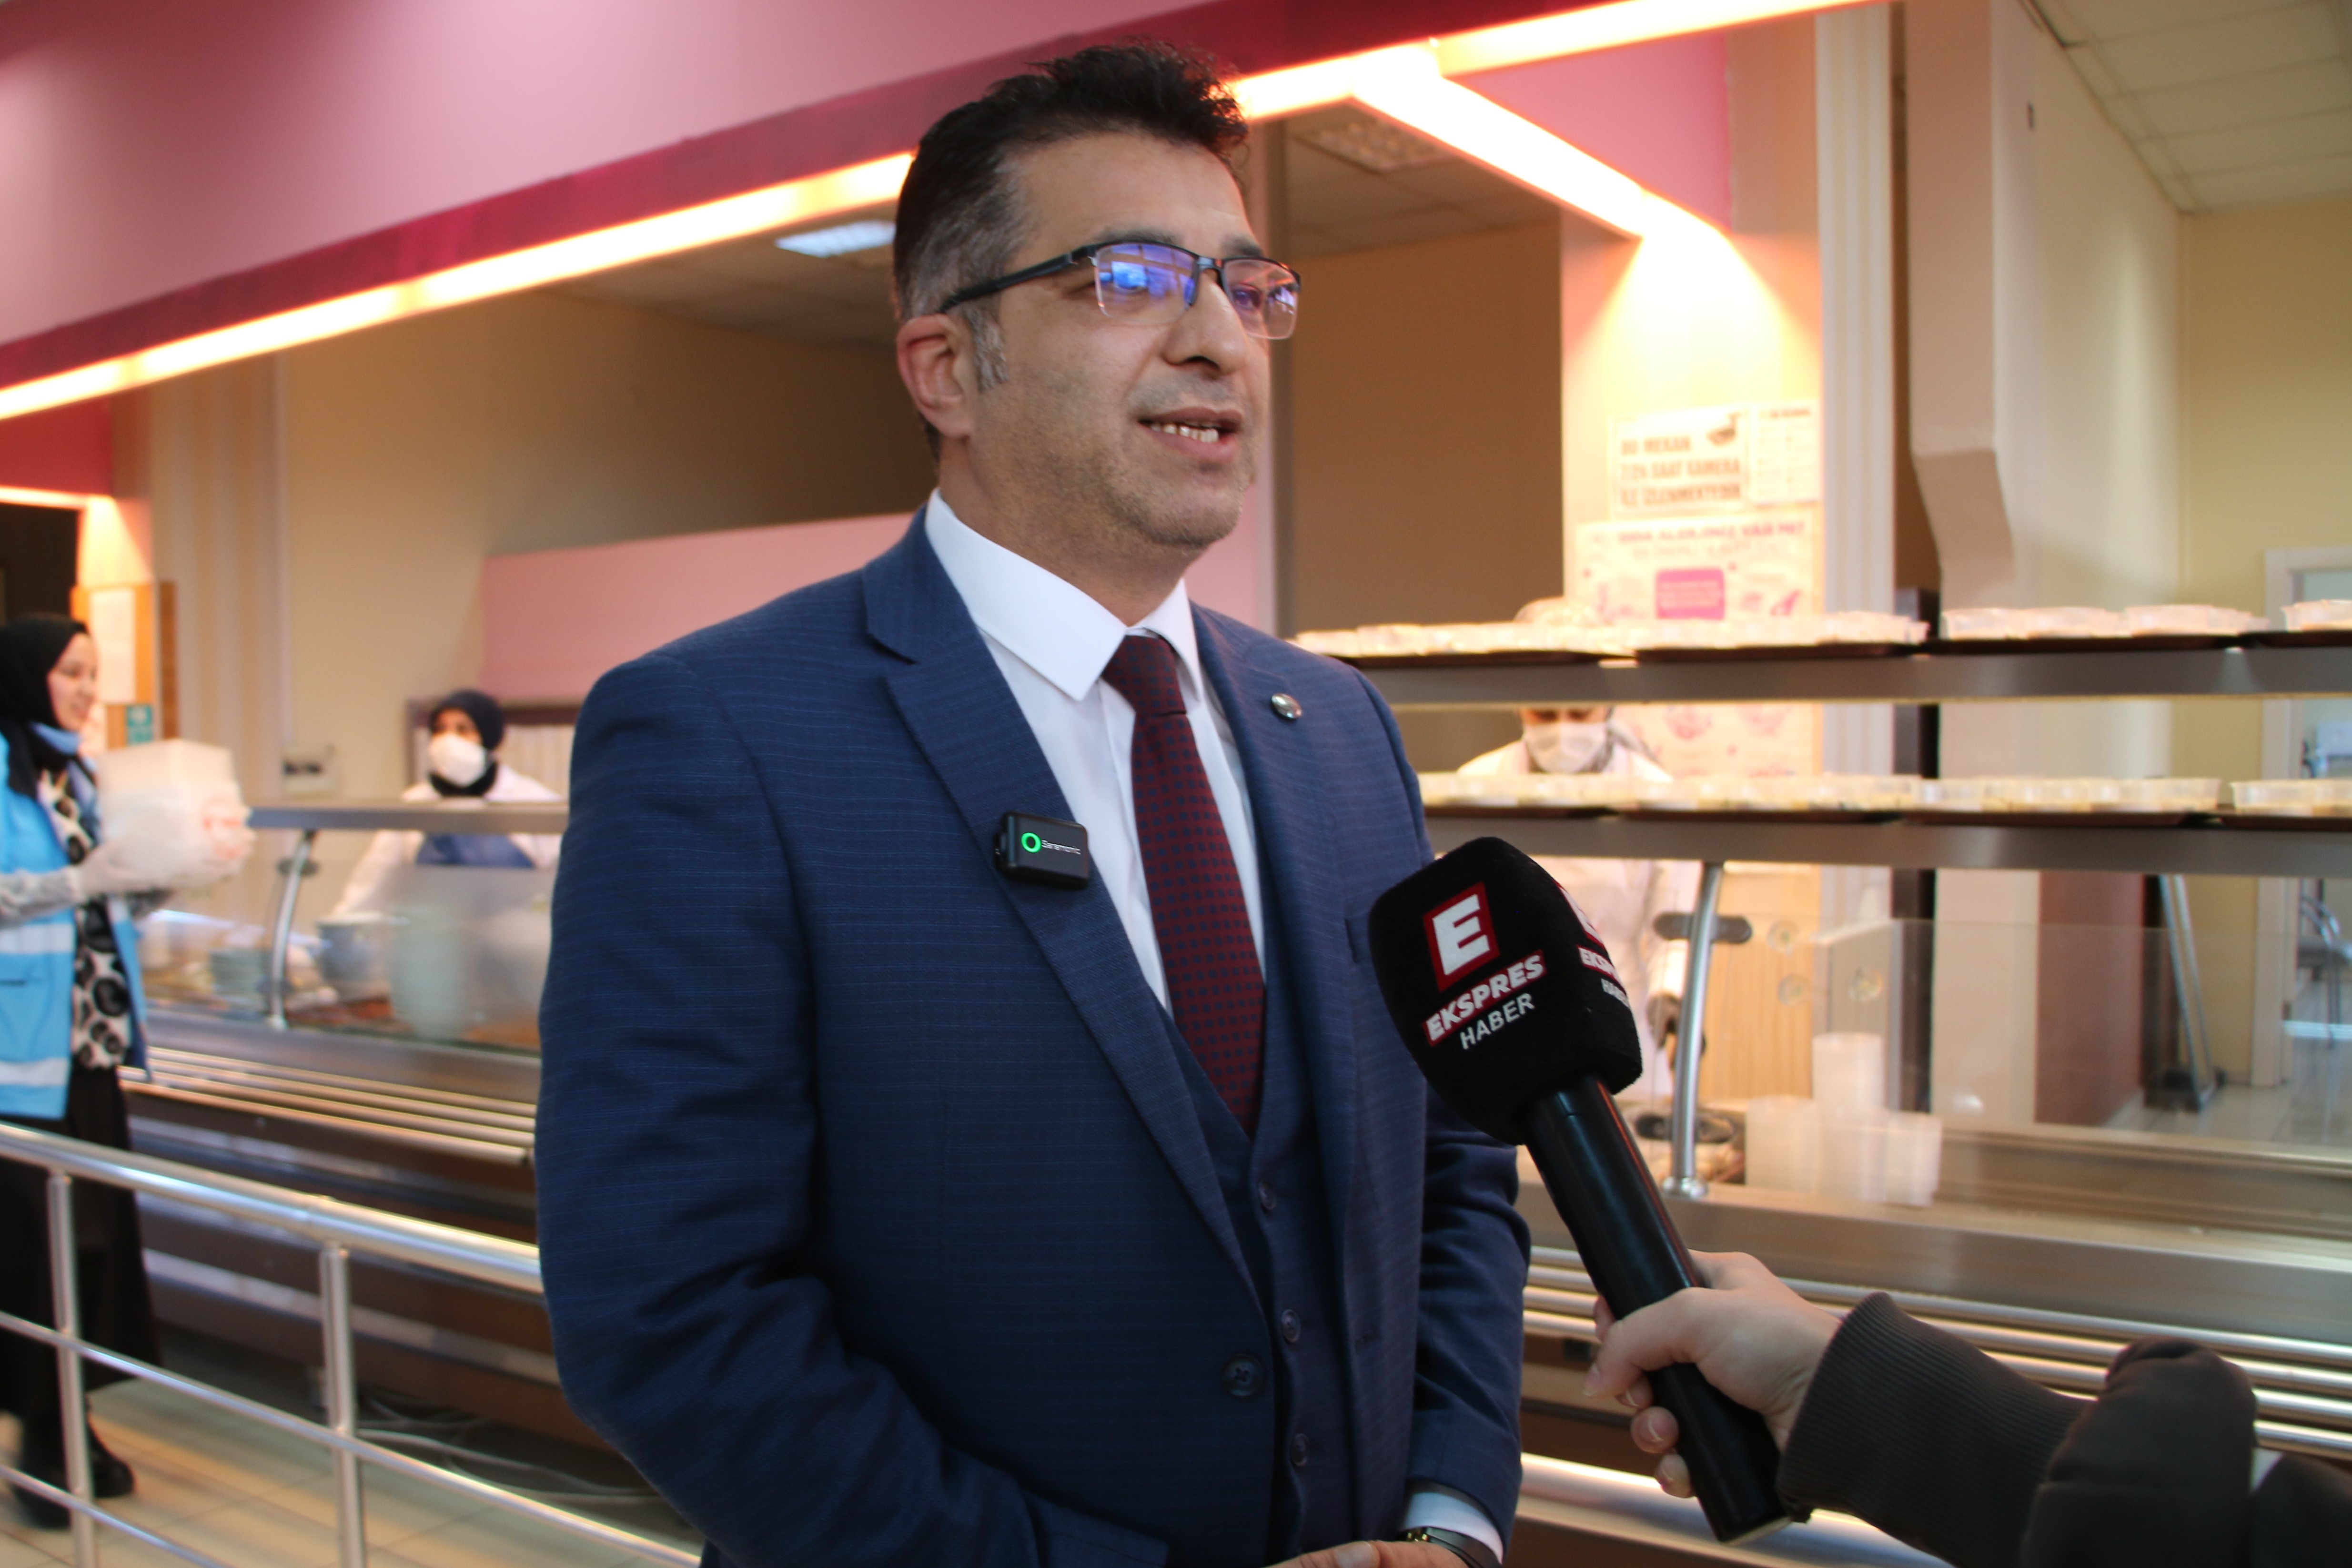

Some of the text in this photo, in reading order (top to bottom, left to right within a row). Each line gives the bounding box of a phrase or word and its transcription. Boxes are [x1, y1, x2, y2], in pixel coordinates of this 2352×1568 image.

[1644, 435, 1690, 454] MEKAN
[1652, 461, 1683, 479] SAAT
[1688, 457, 1740, 475] KAMERA
[1433, 894, 1490, 976] E
[1425, 955, 1544, 1041] EKSPRES
[1459, 993, 1535, 1050] HABER
